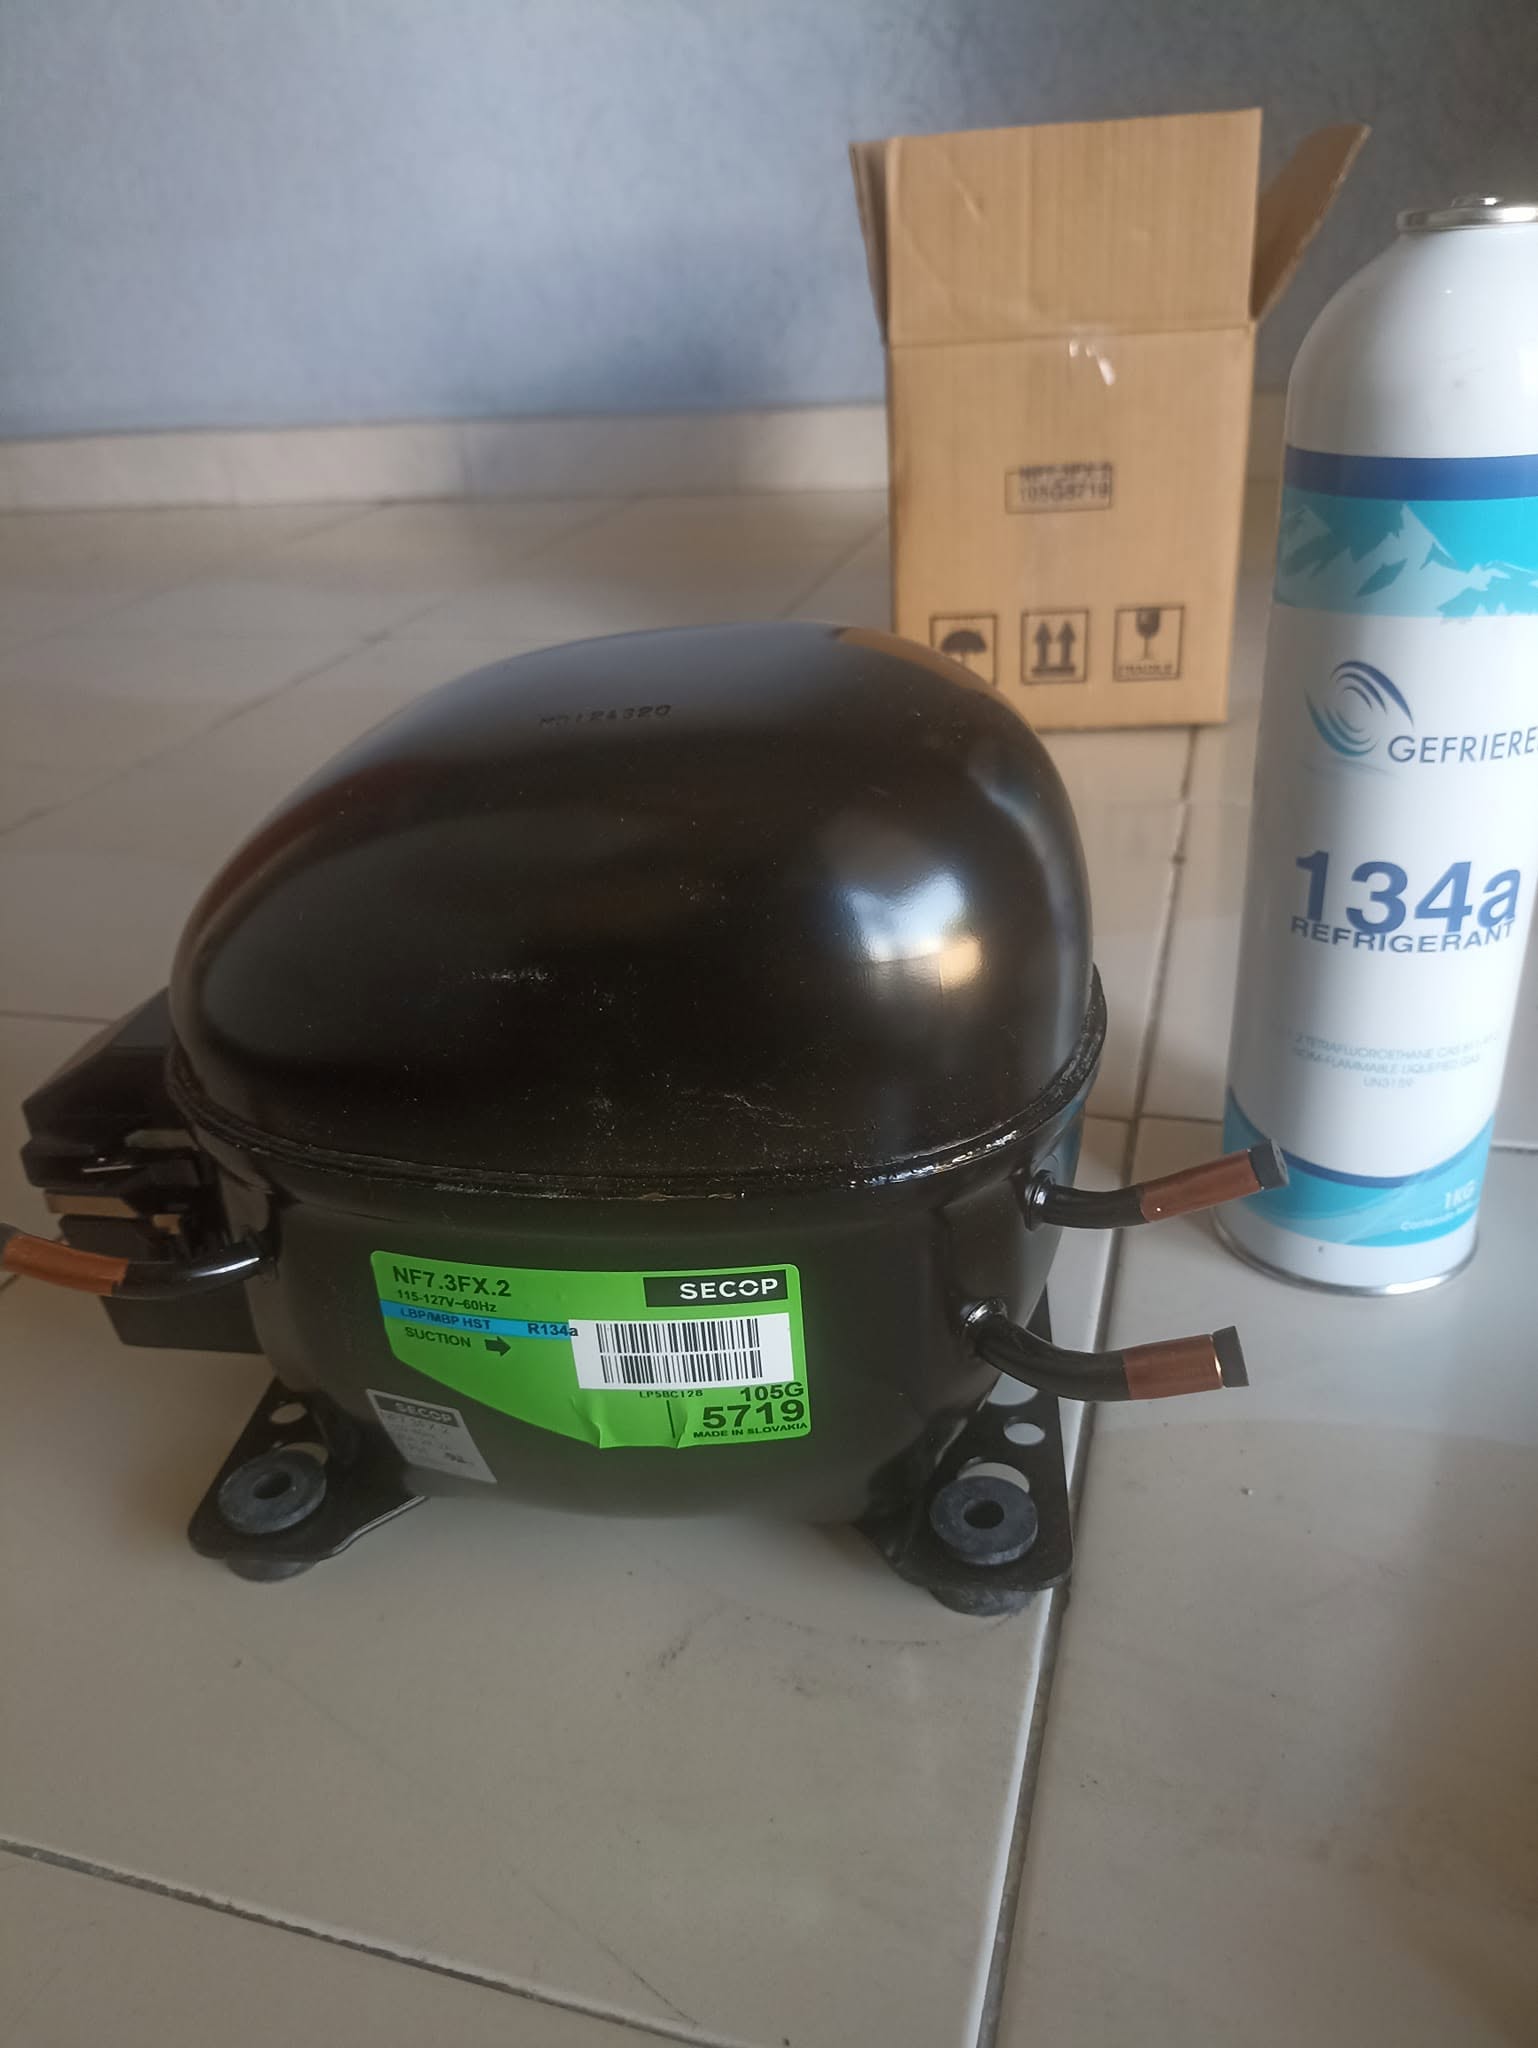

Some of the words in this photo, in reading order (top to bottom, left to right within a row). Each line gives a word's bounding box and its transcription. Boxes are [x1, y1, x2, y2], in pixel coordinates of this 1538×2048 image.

[1295, 850, 1521, 934] 134a
[1290, 914, 1516, 953] REFRIGERANT
[392, 1265, 512, 1297] NF7.3FX.2
[679, 1278, 778, 1299] SECOP
[400, 1307, 460, 1326] LBP/MBP
[462, 1318, 491, 1330] HST
[527, 1322, 580, 1337] R134a
[404, 1326, 472, 1348] SUCTION
[740, 1381, 804, 1402] 105G
[394, 1402, 453, 1423] SECOP
[702, 1399, 805, 1429] 5719
[693, 1430, 729, 1439] MADE
[731, 1429, 744, 1437] IN
[747, 1422, 808, 1435] SLOVAKIA
